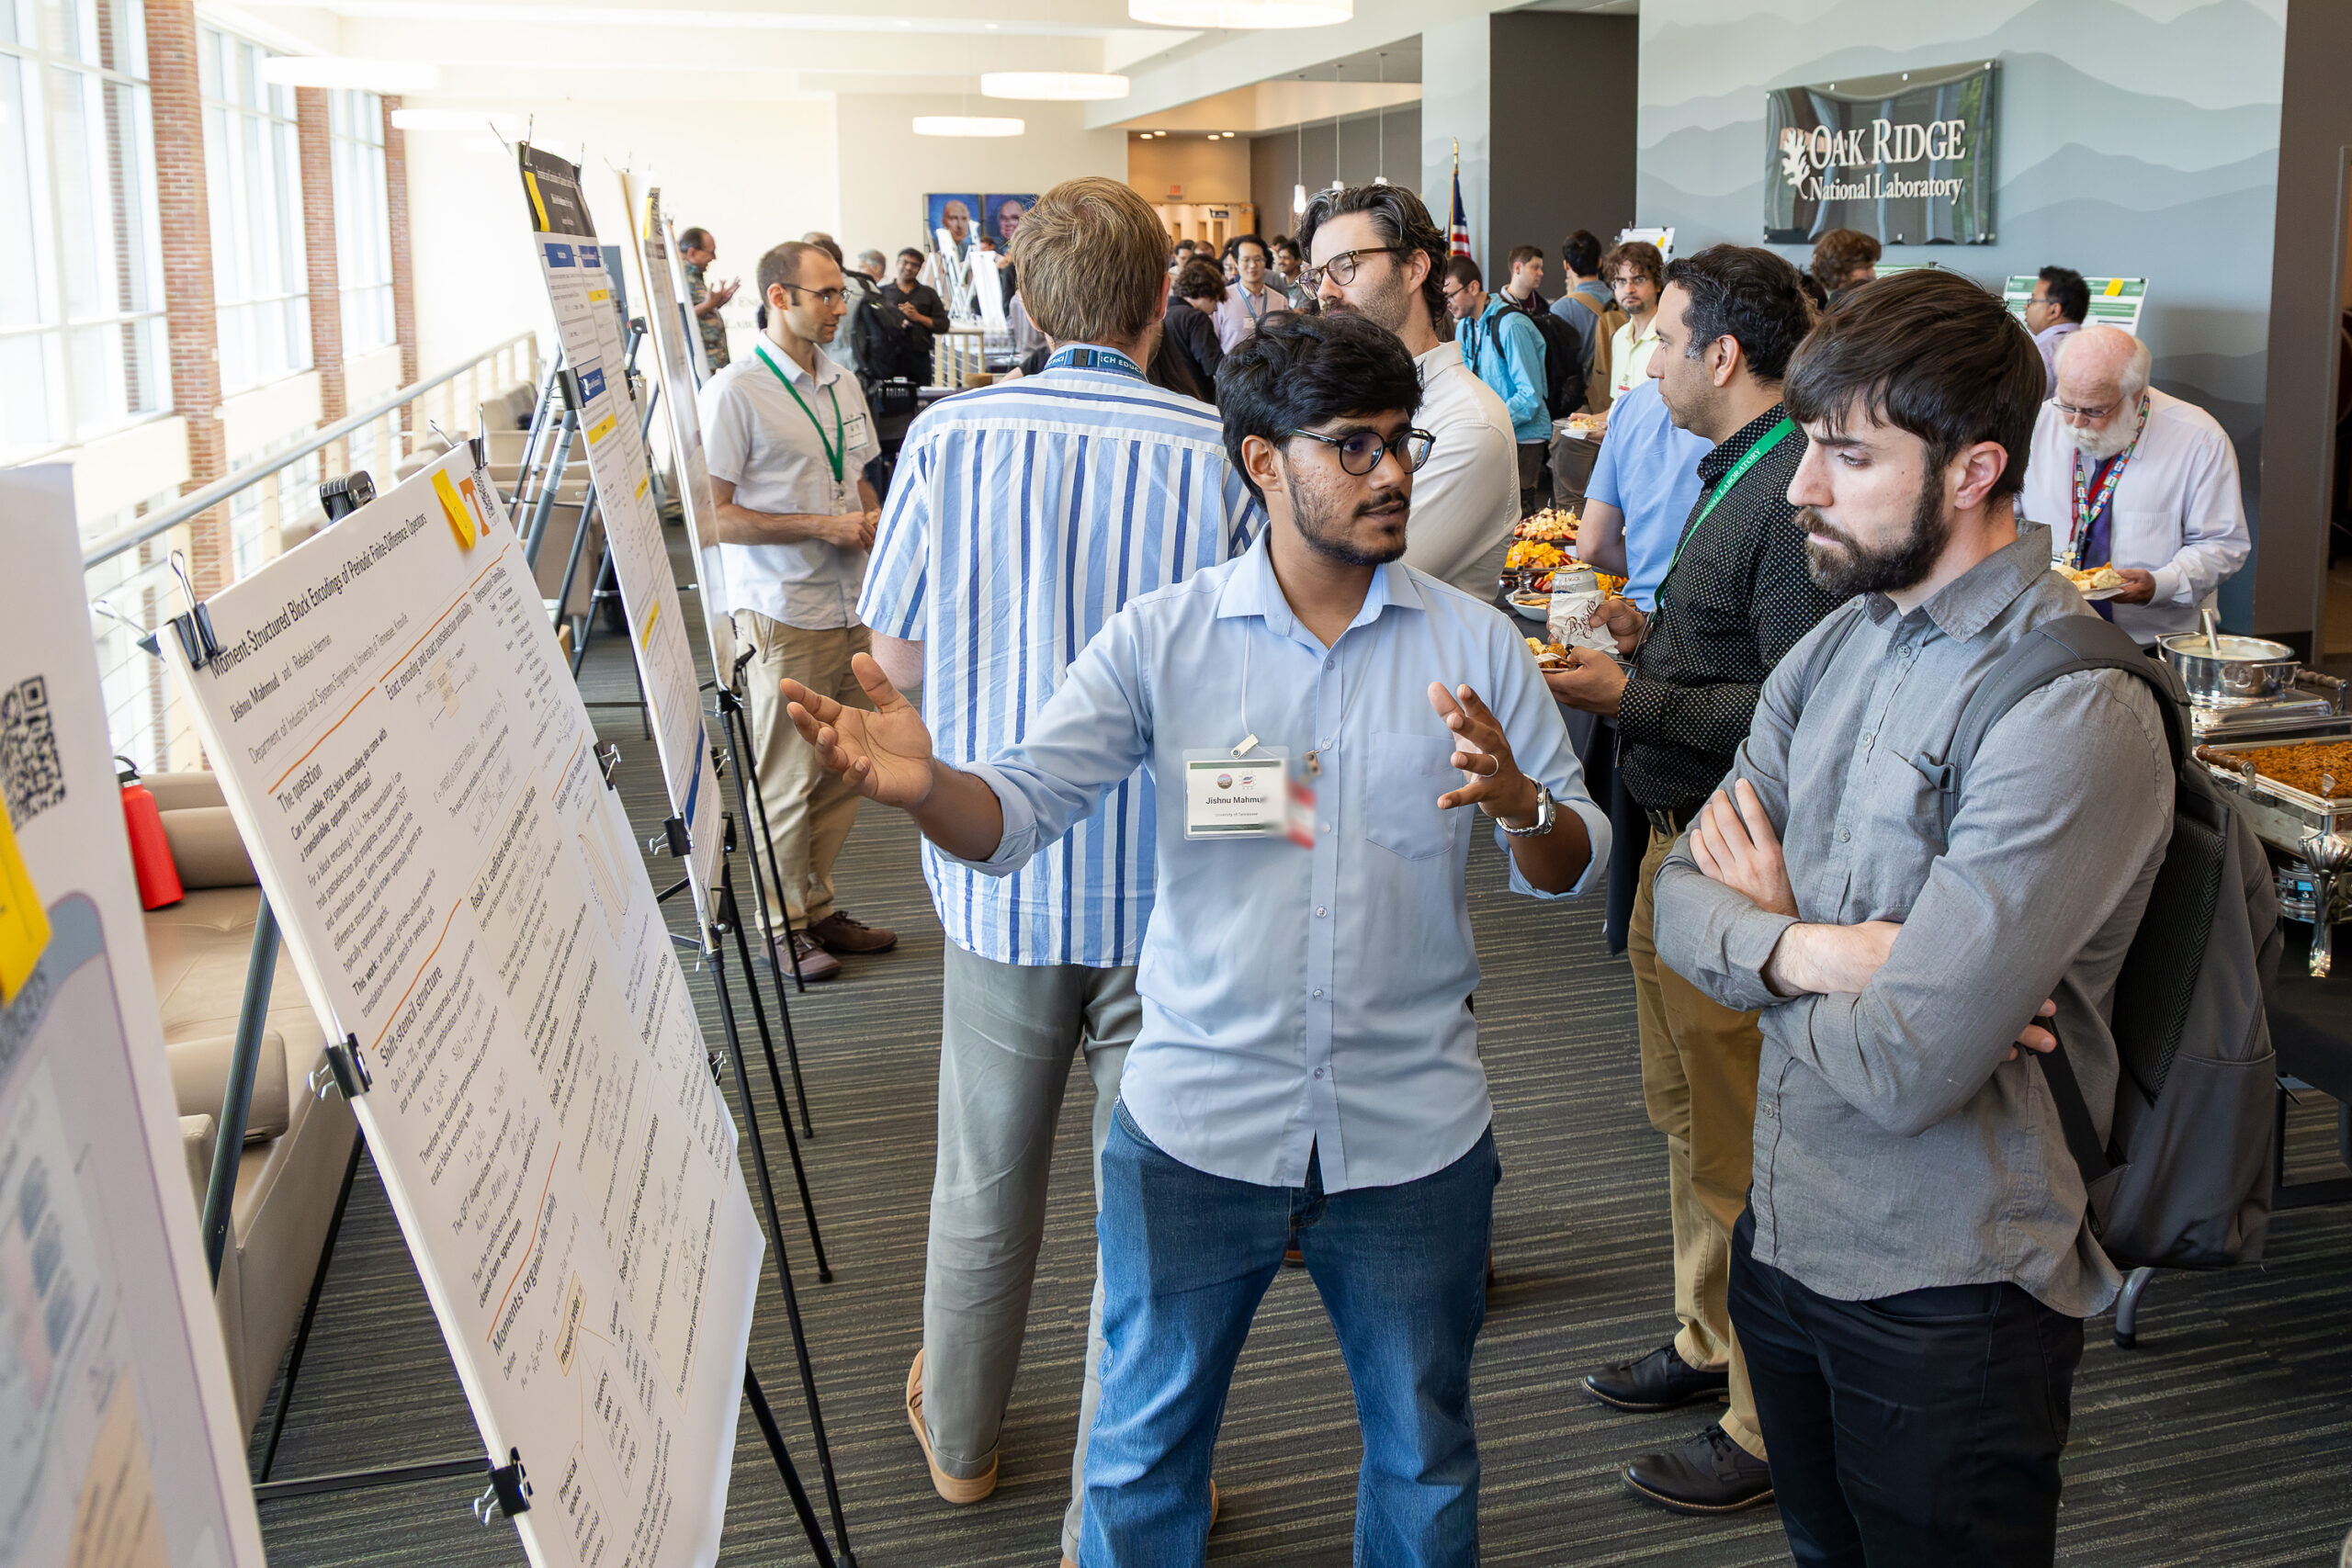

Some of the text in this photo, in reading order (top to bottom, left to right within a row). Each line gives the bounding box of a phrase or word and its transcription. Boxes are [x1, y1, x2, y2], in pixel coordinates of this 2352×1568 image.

[1810, 119, 1966, 169] OAK RIDGE
[1809, 173, 1964, 205] National Laboratory
[1718, 448, 1762, 496] LABORATORY
[209, 512, 427, 679] Moment-Structured Block Encodings of Periodic Finite-Difference Operators
[229, 698, 252, 723] Jishnu
[248, 672, 280, 704] Mahmud
[280, 662, 292, 681] and
[247, 729, 281, 764] Department
[279, 717, 289, 737] of
[284, 702, 308, 730] Industrial
[306, 694, 319, 712] and
[314, 680, 336, 705] Systems
[354, 645, 375, 667] University
[384, 678, 402, 701] Exact
[399, 660, 422, 687] encoding
[416, 648, 428, 668] and
[424, 640, 438, 659] exact
[276, 763, 322, 813] The question
[290, 823, 303, 841] Can
[300, 819, 307, 830] a
[304, 798, 325, 825] reusable
[322, 784, 336, 804] PDE
[331, 774, 346, 793] block
[344, 756, 366, 781] encoding
[368, 737, 380, 754] come
[377, 727, 388, 742] with
[299, 771, 372, 863] a transferable optimality certificate?
[1205, 795, 1265, 805] Jishnu Mahmu
[306, 873, 317, 889] For
[316, 855, 331, 876] block
[329, 836, 352, 862] encoding
[361, 810, 372, 824] the
[324, 832, 400, 931] and simulation constructions
[325, 862, 354, 900] postselection
[352, 851, 362, 868] and
[376, 821, 386, 836] into
[378, 871, 392, 890] known
[390, 850, 408, 876] optimality
[469, 883, 486, 911] Result
[480, 875, 490, 891] 1:
[509, 809, 526, 839] optimality
[342, 943, 363, 974] typically
[351, 976, 367, 996] This
[377, 951, 384, 964] an
[361, 960, 399, 1017] translation-invariant
[406, 935, 414, 948] on
[412, 915, 429, 942] periodic
[379, 966, 443, 1067] Shift-stencil structure
[406, 1000, 462, 1100] is already a linear combination of
[390, 1077, 400, 1093] On
[416, 1034, 426, 1050] any
[549, 1078, 561, 1109] Result
[562, 1034, 575, 1073] moments
[571, 1009, 582, 1039] recover
[418, 1130, 440, 1164] Therefore
[437, 1118, 447, 1135] the
[443, 1090, 461, 1123] standard
[430, 1100, 474, 1186] exact block encoding with
[451, 1217, 464, 1235] The
[459, 1195, 470, 1221] QFT
[487, 1149, 496, 1164] the
[493, 1132, 503, 1153] same
[470, 1265, 483, 1287] Thus
[479, 1252, 488, 1269] the
[485, 1213, 508, 1255] coefficients
[505, 1188, 519, 1219] provide
[478, 1218, 522, 1308] closed-form spectrum
[492, 1191, 557, 1355] Moments organize the family
[502, 1351, 516, 1381] Define
[560, 1294, 580, 1365] moment order
[593, 1369, 609, 1414] Frequency
[603, 1395, 613, 1422] space
[558, 1457, 577, 1504] Physical
[568, 1484, 582, 1516] space
[633, 1517, 644, 1540] fixes
[640, 1502, 649, 1520] the
[645, 1459, 658, 1505] differential
[579, 1510, 600, 1563] differential
[637, 1488, 663, 1564] the full coefficient
